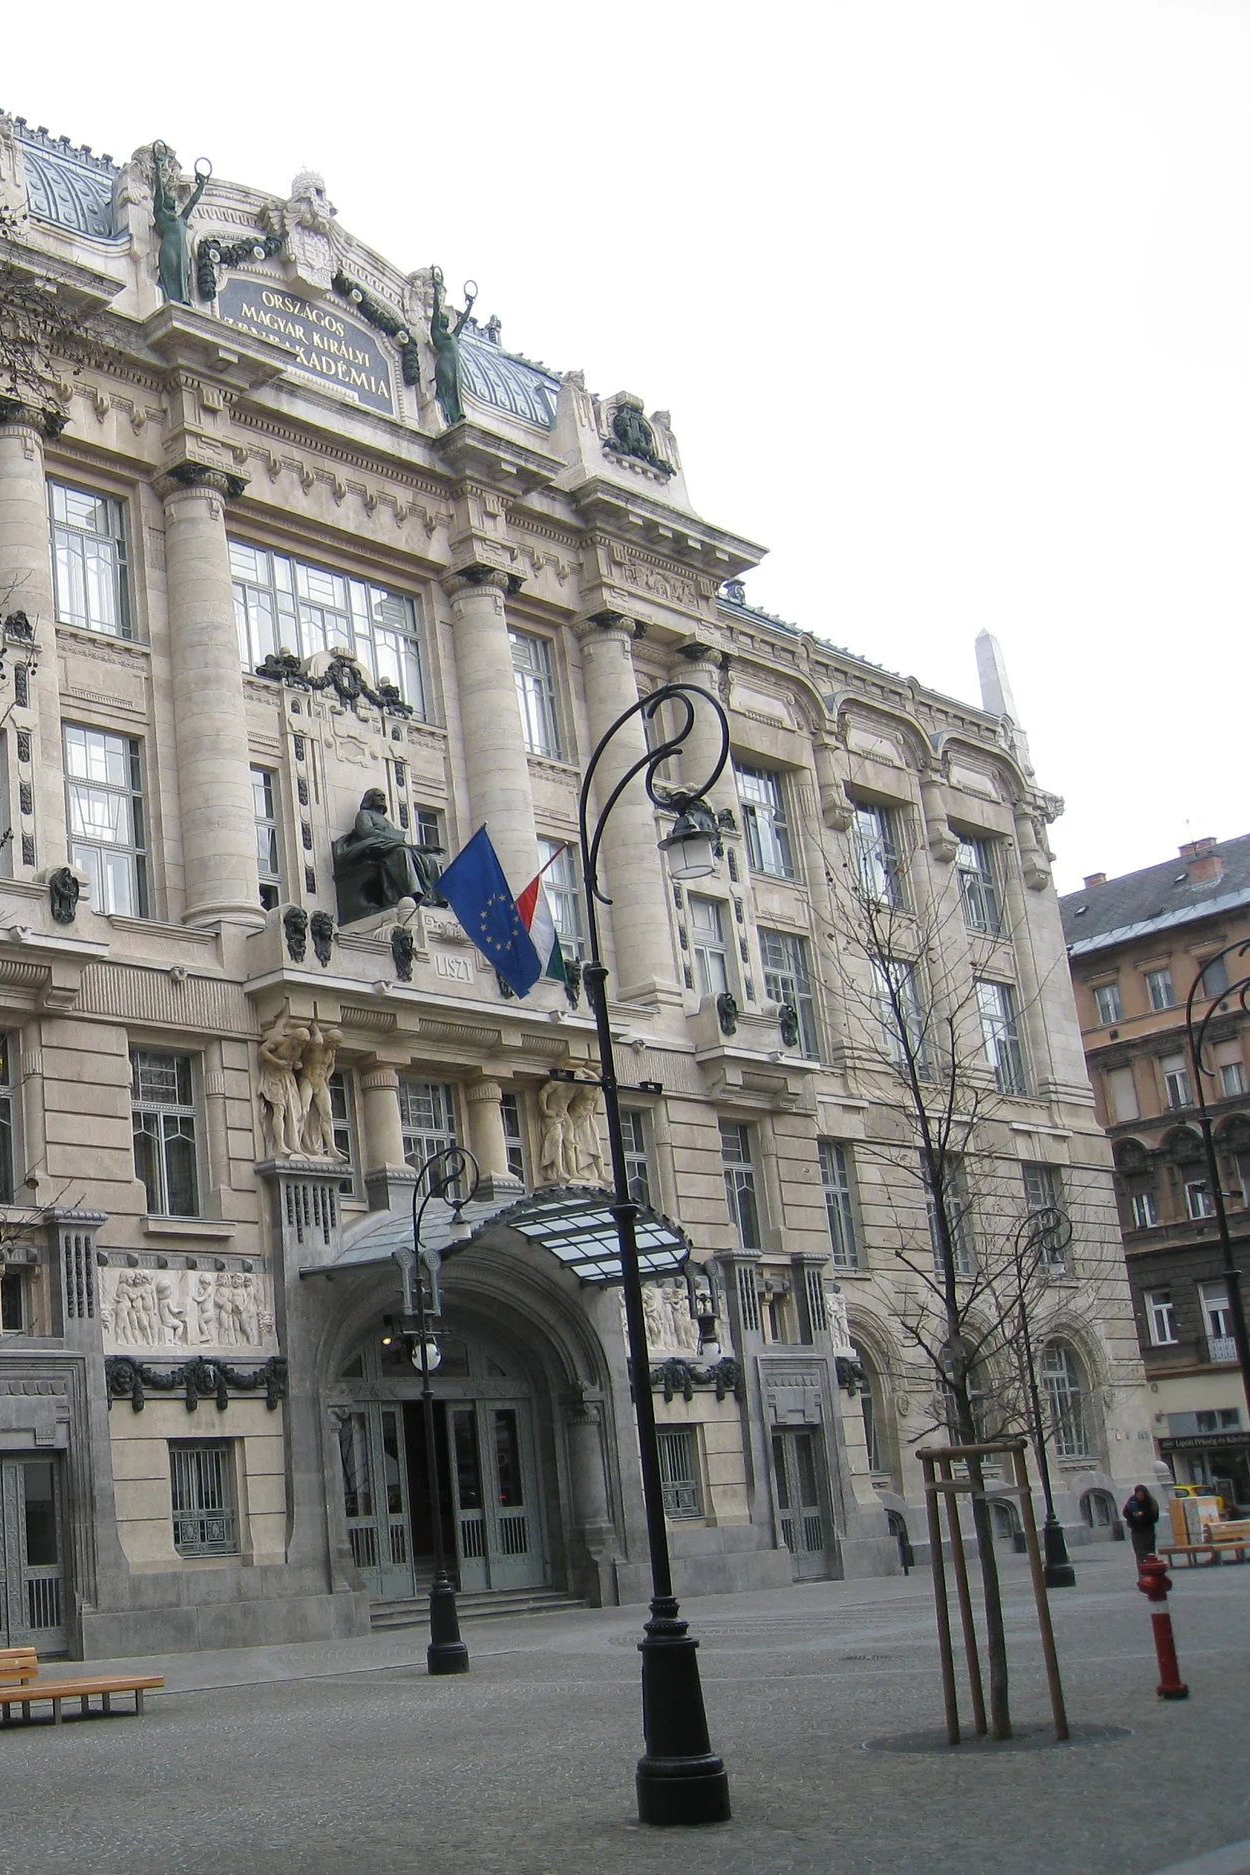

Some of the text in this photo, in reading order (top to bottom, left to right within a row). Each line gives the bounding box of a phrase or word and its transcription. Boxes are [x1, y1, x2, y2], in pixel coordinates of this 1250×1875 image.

[241, 302, 370, 368] MAGYAR KIRÁLYI
[262, 291, 345, 338] ORSZÁGOS
[435, 954, 471, 981] LISZT
